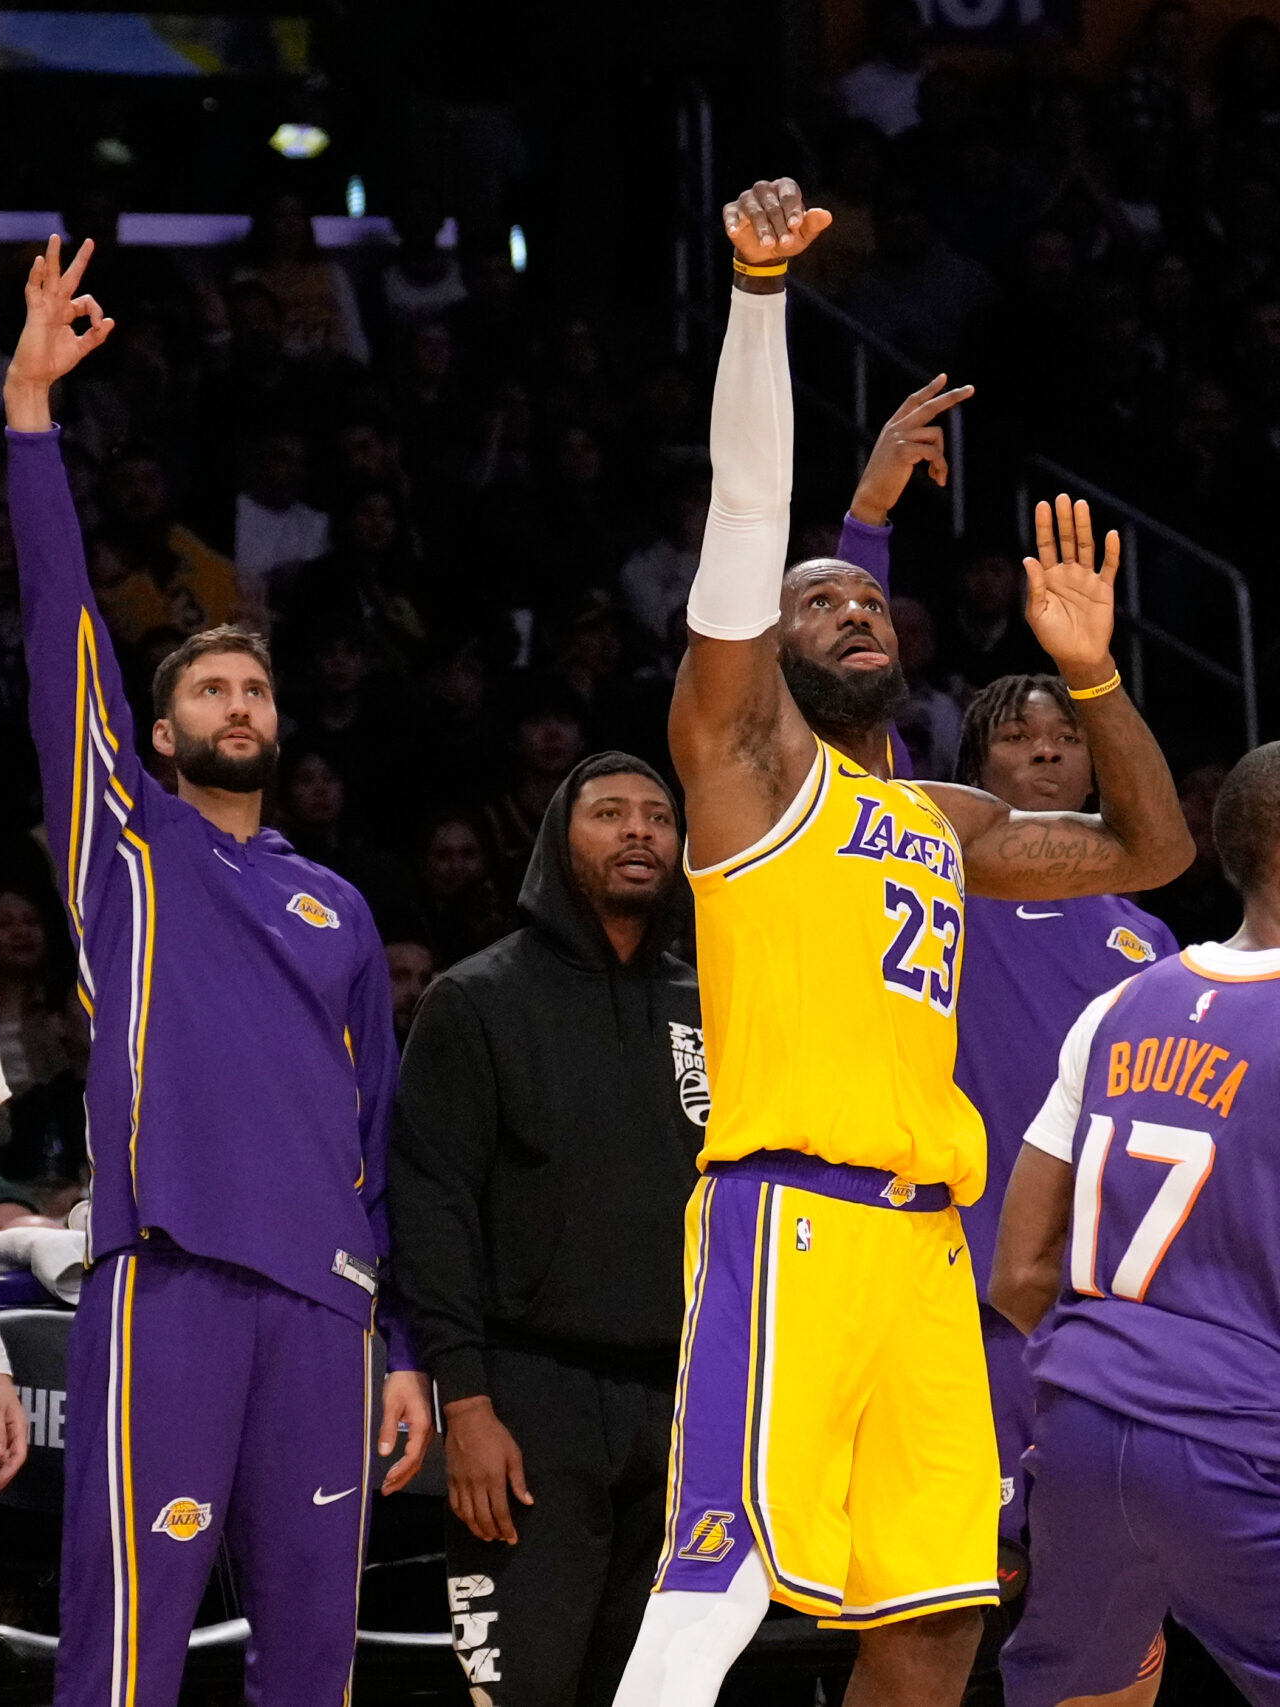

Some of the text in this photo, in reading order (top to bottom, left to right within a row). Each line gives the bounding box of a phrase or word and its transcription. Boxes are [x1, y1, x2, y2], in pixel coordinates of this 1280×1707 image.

[882, 877, 962, 1019] 23
[672, 1049, 708, 1081] HOO
[1106, 1036, 1249, 1119] BOUYEA
[1070, 1112, 1217, 1304] 17
[15, 1385, 67, 1449] HE
